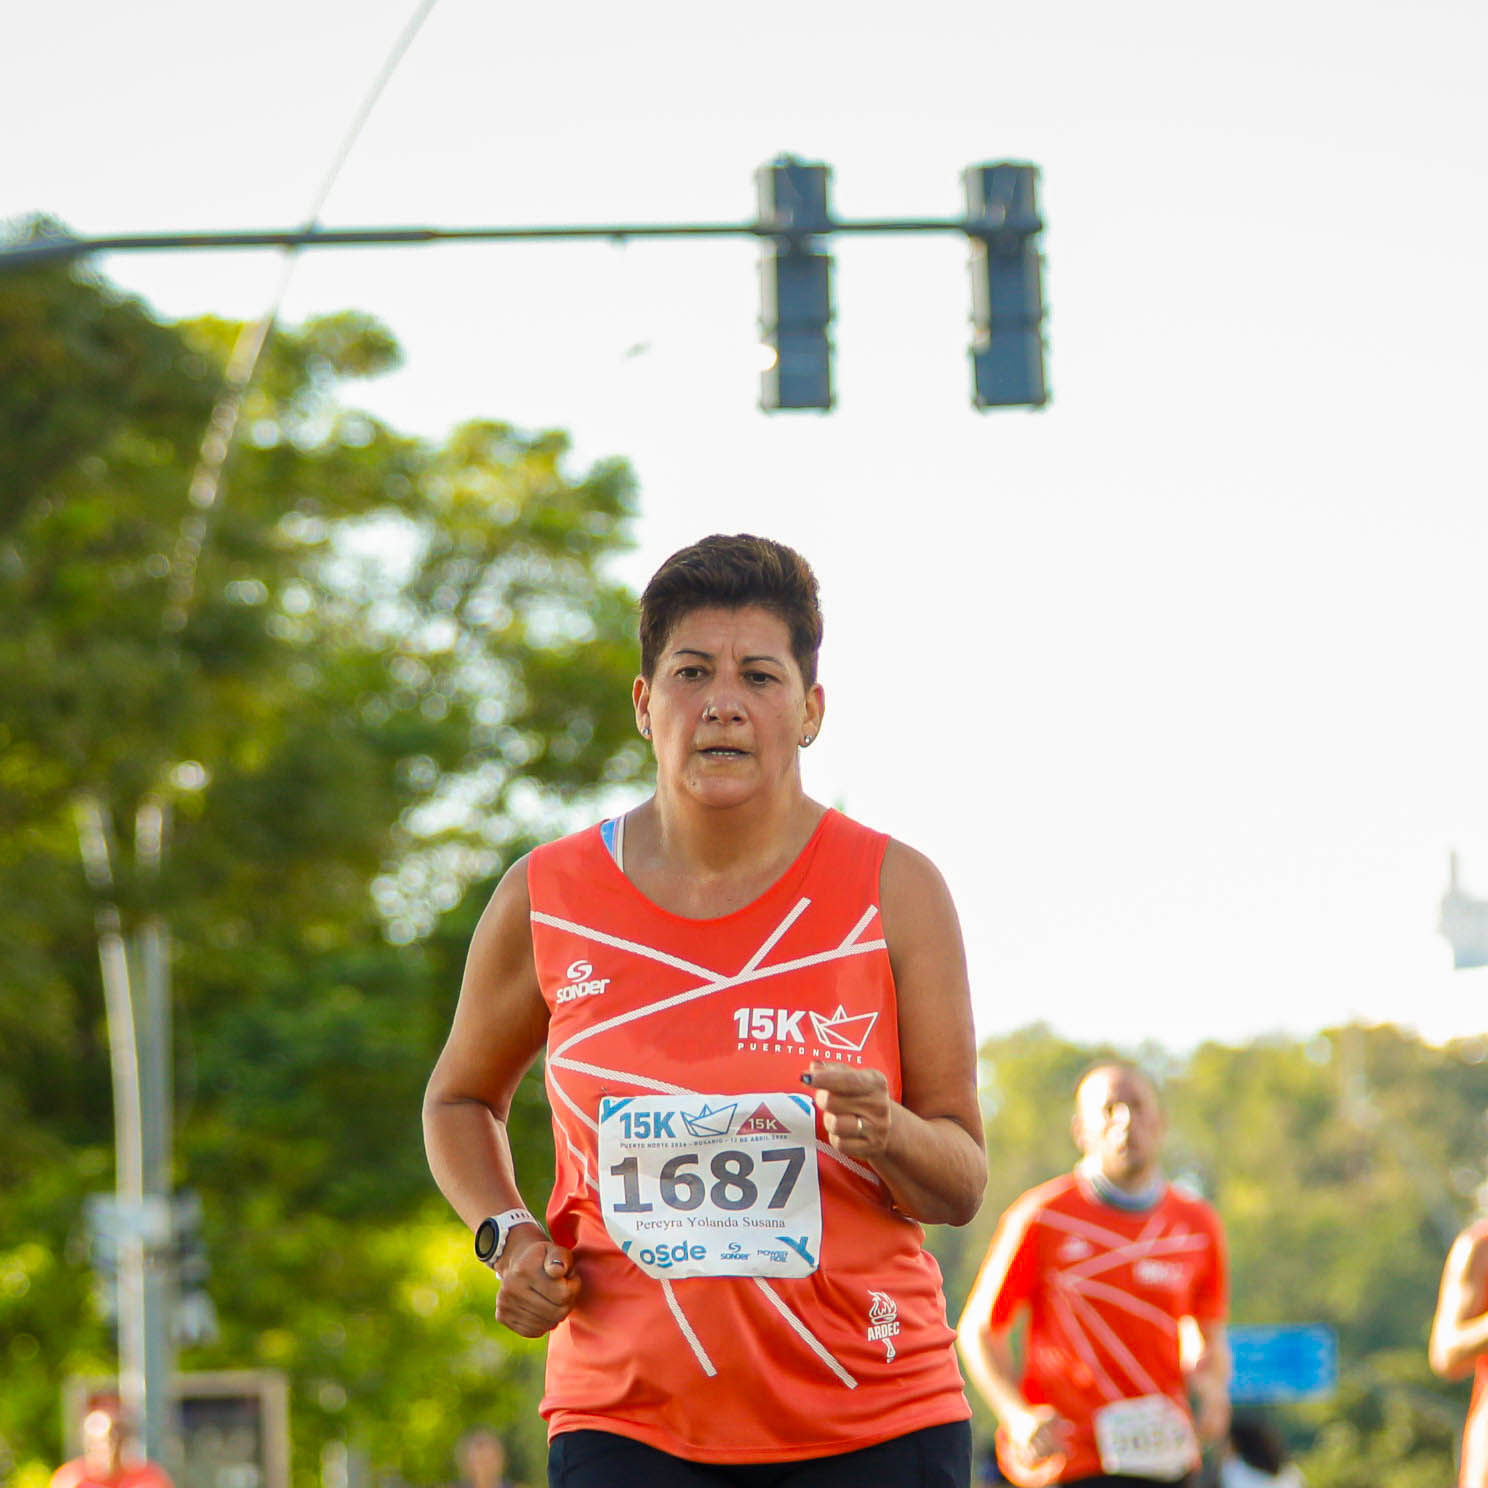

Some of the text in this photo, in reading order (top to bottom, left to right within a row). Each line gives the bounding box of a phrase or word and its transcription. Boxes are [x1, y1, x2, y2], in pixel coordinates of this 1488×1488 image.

[733, 1008, 806, 1043] 15K
[737, 1042, 862, 1064] PUERTO NORTE
[619, 1111, 676, 1139] 15K
[747, 1118, 777, 1131] 15K
[610, 1146, 807, 1213] 1687
[636, 1216, 786, 1231] Pereyra Yolanda Susana
[867, 1321, 901, 1342] ARDEC
